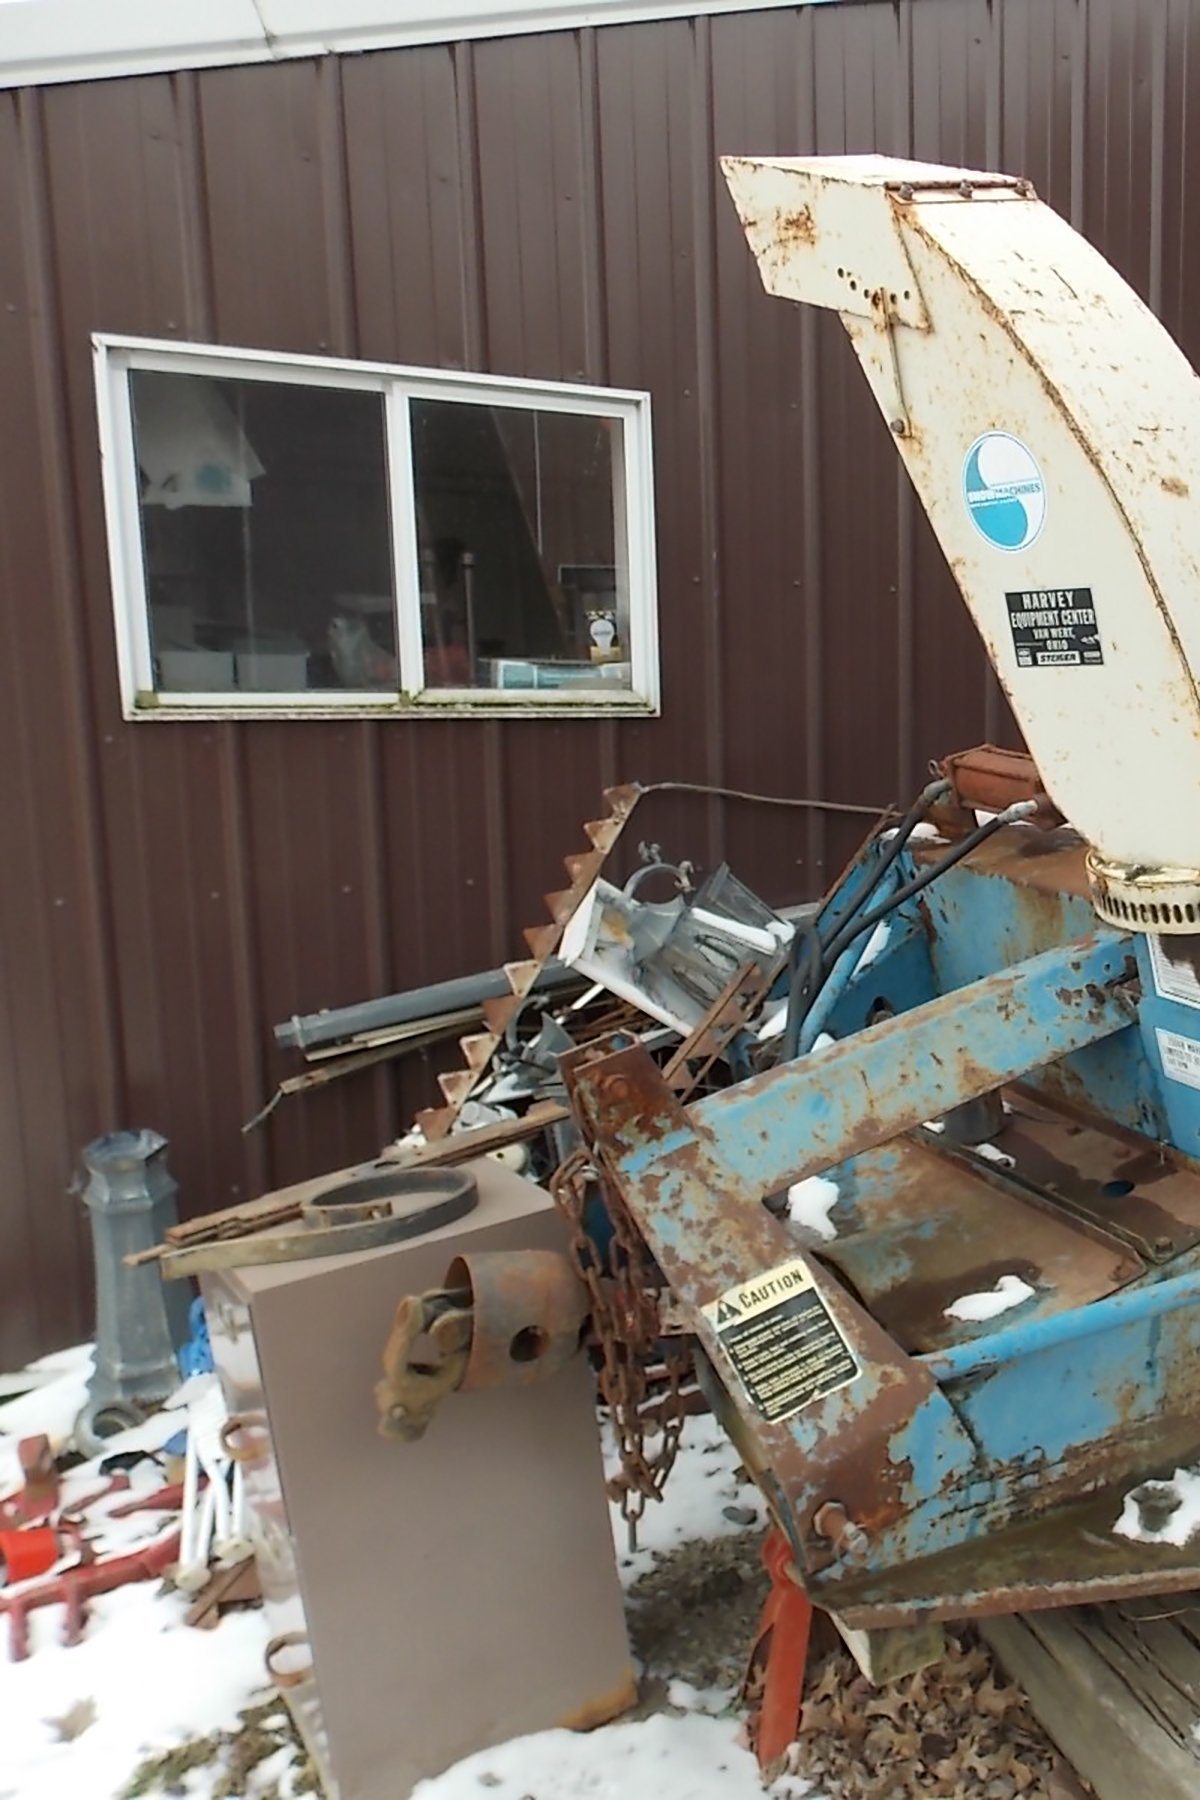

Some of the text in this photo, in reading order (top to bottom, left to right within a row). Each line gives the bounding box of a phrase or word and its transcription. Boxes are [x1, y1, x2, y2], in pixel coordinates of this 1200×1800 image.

[1021, 591, 1074, 609] HARVEY
[1010, 608, 1096, 630] EQUIPMENT CENTER
[1046, 639, 1069, 650] OHIO
[1040, 653, 1077, 663] STEIGER
[738, 1269, 804, 1309] CAUTION
